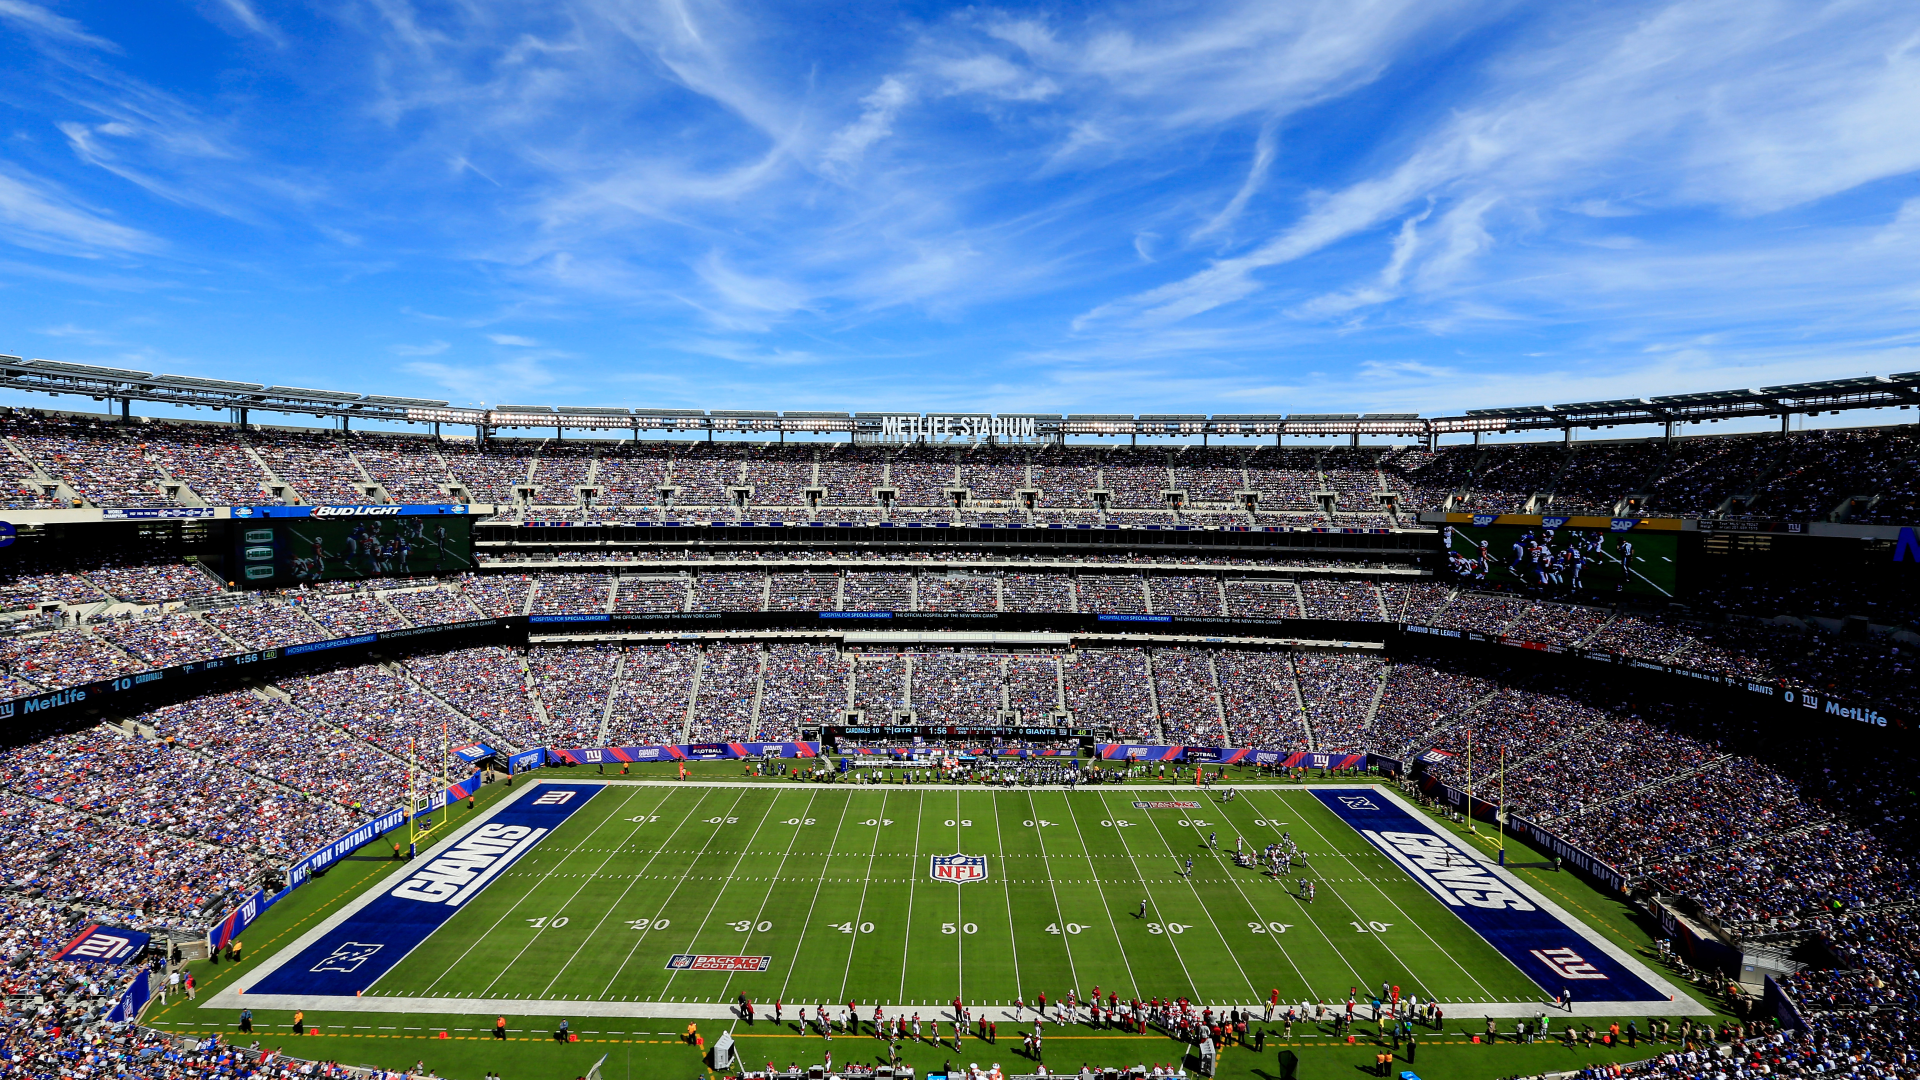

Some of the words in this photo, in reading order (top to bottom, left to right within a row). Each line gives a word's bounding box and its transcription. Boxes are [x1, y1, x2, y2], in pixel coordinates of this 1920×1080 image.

[882, 416, 954, 436] METLIFE
[960, 416, 1034, 436] STADIUM
[317, 506, 355, 516] BUD
[355, 506, 402, 516] LIGHT
[1474, 516, 1492, 525] SAP
[1542, 518, 1562, 527] SAP
[1611, 520, 1632, 530] SAP
[413, 627, 436, 635] HOSPITAL
[1407, 625, 1428, 634] AROUND
[1440, 629, 1461, 638] LEAGUE
[287, 644, 313, 654] HOSPITAL
[327, 638, 349, 648] SPECIAL
[350, 636, 374, 644] SURGERY
[234, 653, 258, 665] 1:56
[112, 678, 131, 691] 10
[135, 671, 163, 684] CARDINALS
[1748, 682, 1773, 695] GIANTS
[1784, 691, 1794, 702] 0
[24, 689, 86, 714] MetLife
[1825, 701, 1887, 727] MetLife
[639, 749, 660, 758] GIANTS
[312, 848, 332, 870] YORK
[335, 826, 373, 856] FOOTBALL
[375, 811, 403, 834] GIANTS
[391, 823, 532, 903] GIANTS
[1553, 842, 1589, 870] FOOTBALL
[1592, 863, 1619, 890] GIANTS
[938, 866, 981, 879] NFL
[1381, 832, 1536, 912] GIANTS
[242, 899, 256, 925] ny
[530, 917, 569, 928] 10
[630, 918, 670, 930] 20
[734, 920, 773, 932] 30
[837, 922, 875, 933] 40
[1146, 922, 1185, 934] 30
[1248, 922, 1286, 934] 20
[1350, 921, 1386, 933] 10
[942, 923, 978, 935] 50
[1045, 923, 1082, 935] 40
[70, 934, 129, 958] ny
[1530, 947, 1609, 980] ny
